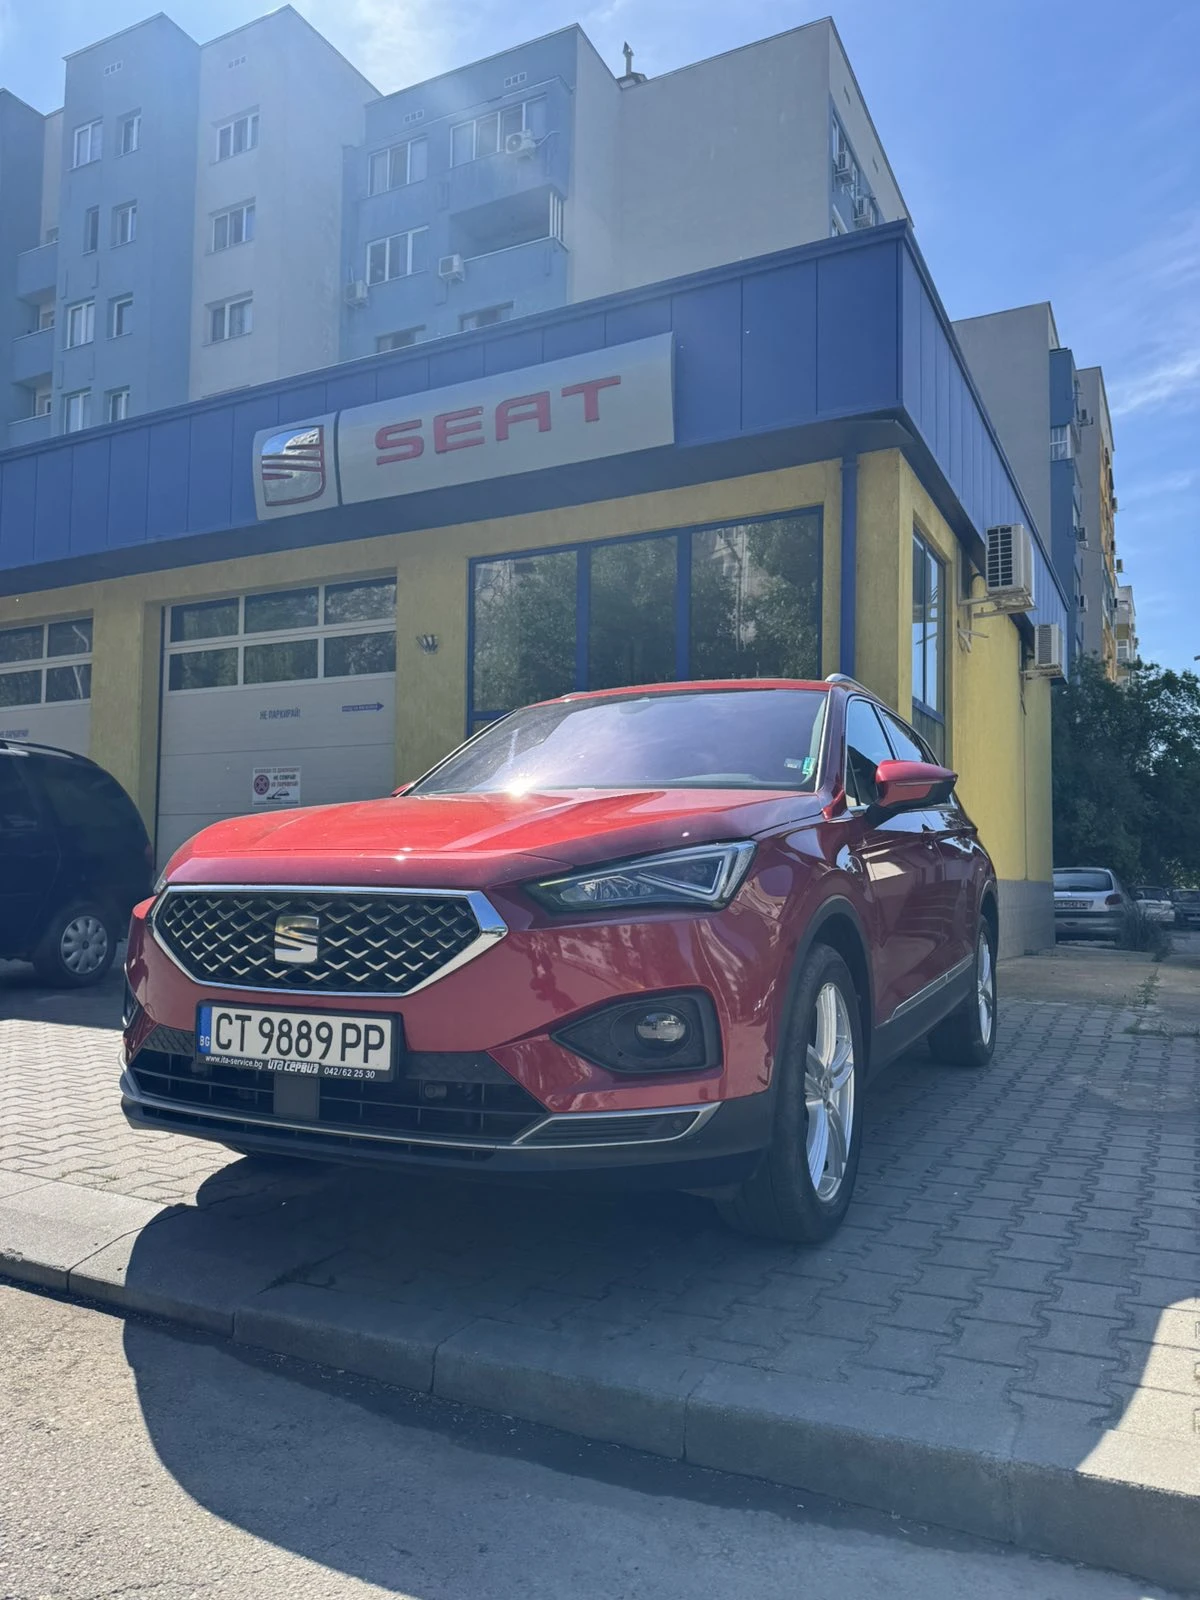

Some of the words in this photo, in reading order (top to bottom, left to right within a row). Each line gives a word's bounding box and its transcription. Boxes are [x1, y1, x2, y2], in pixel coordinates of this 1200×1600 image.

[375, 375, 621, 466] SEAT
[200, 1035, 211, 1047] BG
[215, 1012, 252, 1052] CT
[258, 1016, 334, 1060] 9889
[340, 1022, 385, 1064] PP
[205, 1055, 263, 1070] www.ita-service.bg
[324, 1066, 352, 1077] 042/62
[353, 1069, 363, 1078] 25
[365, 1070, 376, 1079] 30
